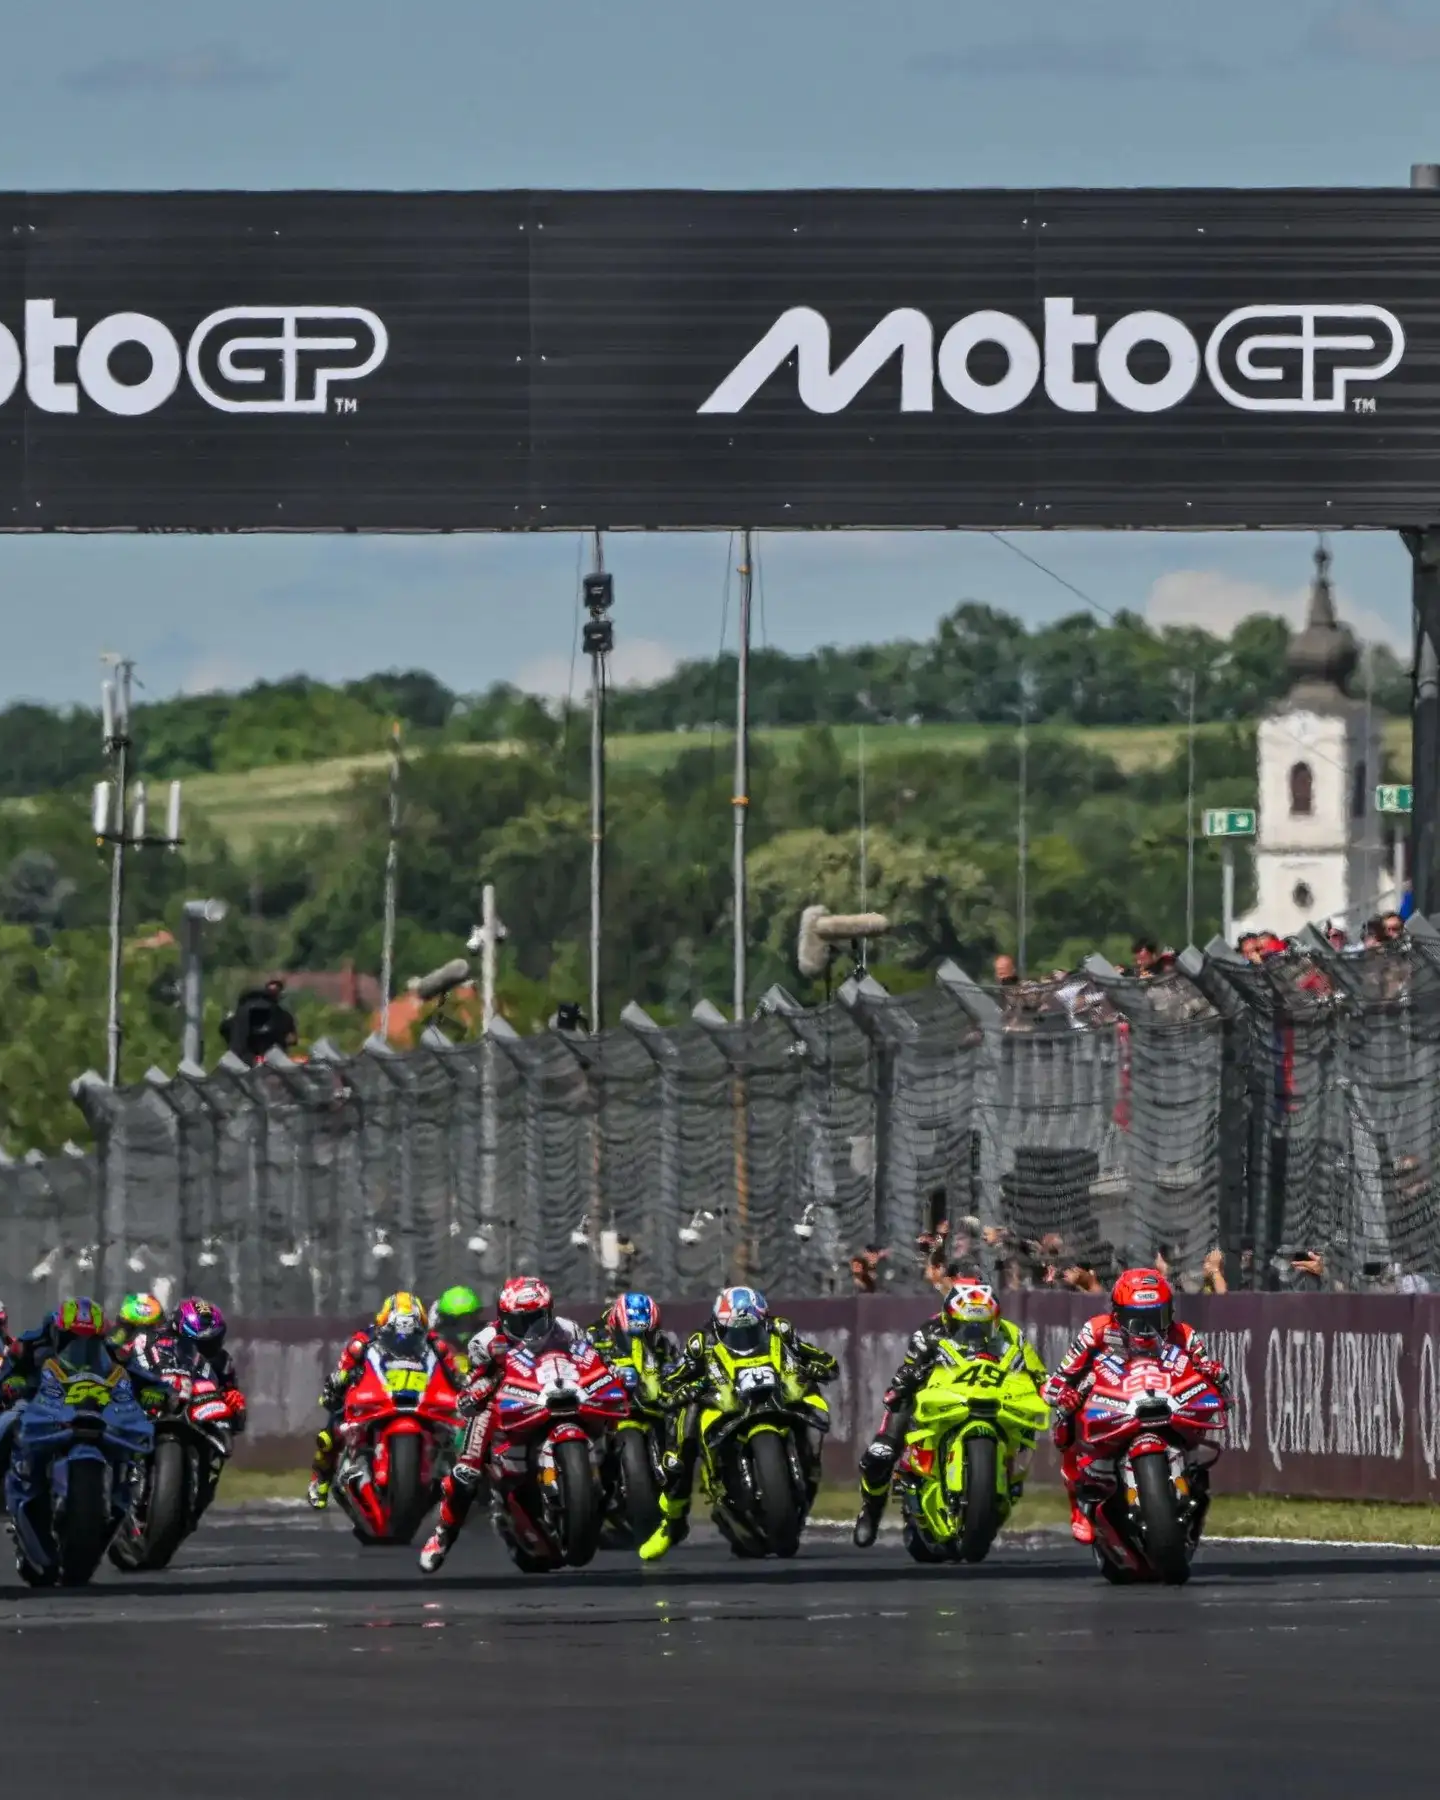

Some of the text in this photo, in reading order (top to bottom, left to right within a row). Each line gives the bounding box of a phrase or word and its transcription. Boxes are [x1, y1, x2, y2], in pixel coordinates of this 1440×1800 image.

[697, 297, 1406, 414] MotoGP
[952, 1365, 1008, 1388] 49
[503, 1385, 539, 1401] Lenovo
[1091, 1393, 1127, 1409] Lenovo
[1175, 1382, 1208, 1403] Lenovo
[1265, 1328, 1325, 1471] QATAR
